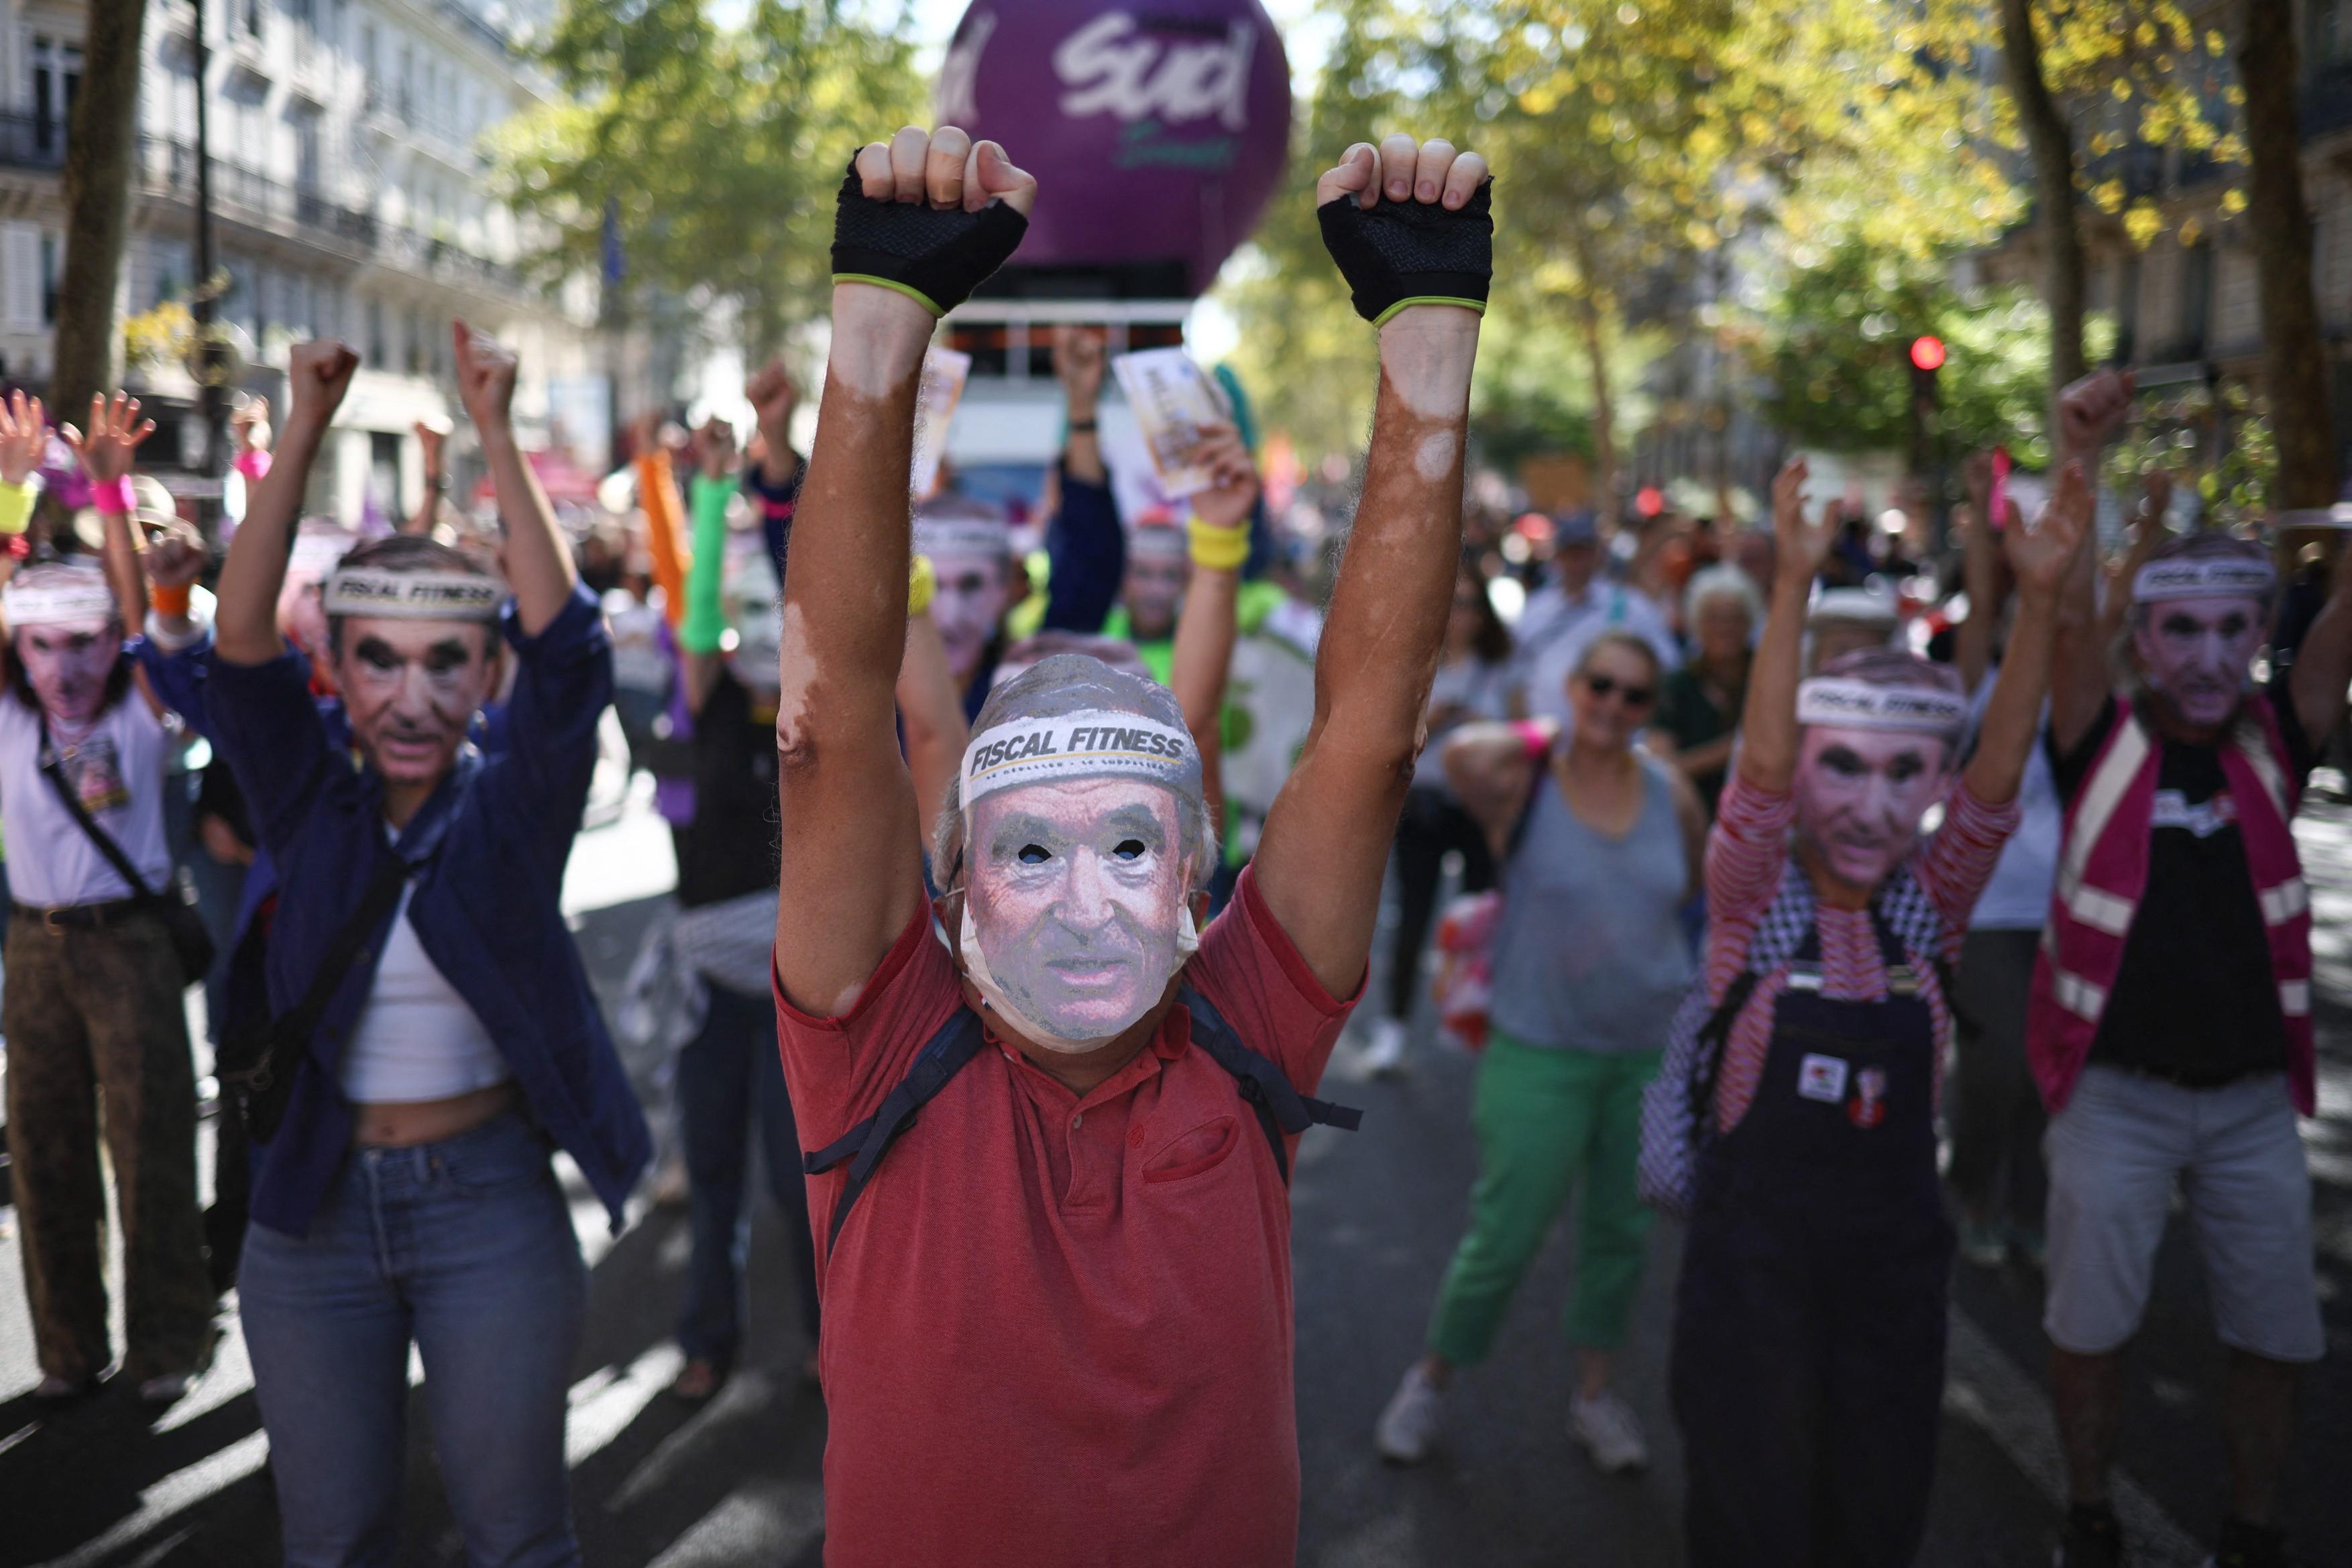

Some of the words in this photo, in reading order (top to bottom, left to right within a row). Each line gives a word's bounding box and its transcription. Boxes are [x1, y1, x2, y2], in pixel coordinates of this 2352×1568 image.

[1054, 9, 1256, 130] Sud
[339, 577, 398, 596] FISCAL
[409, 582, 494, 599] FITNESS
[970, 730, 1056, 777] FISCAL
[1067, 727, 1184, 758] FITNESS
